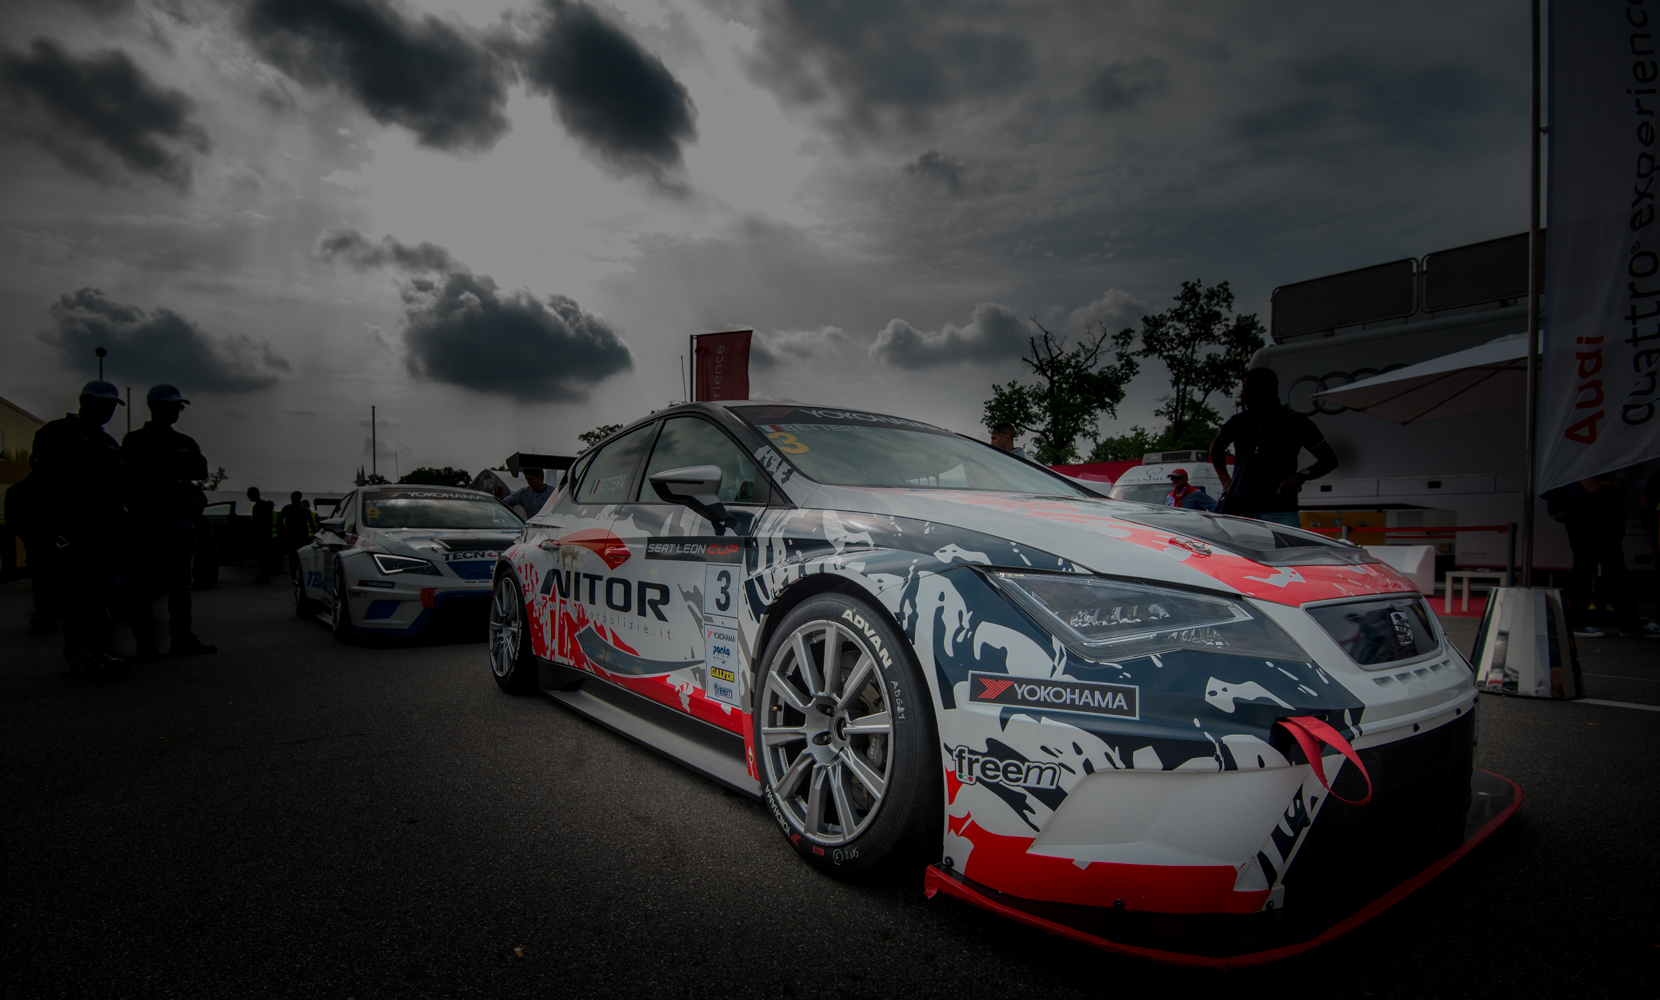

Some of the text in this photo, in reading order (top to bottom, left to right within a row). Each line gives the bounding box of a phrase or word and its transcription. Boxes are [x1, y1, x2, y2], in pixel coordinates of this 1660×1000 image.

[1626, 0, 1660, 231] experienc
[712, 344, 725, 401] rience
[1564, 335, 1604, 444] Audi
[768, 432, 809, 454] 3
[406, 491, 486, 500] YOKOHAMA
[366, 508, 380, 518] 9
[647, 543, 739, 555] SEAT LEON CUP
[540, 568, 670, 623] NITOR
[715, 570, 731, 611] 3
[713, 632, 736, 643] YOKOHAMA
[841, 608, 893, 669] ADVAN
[711, 667, 735, 682] GALFER
[714, 682, 733, 699] freem
[1014, 683, 1128, 711] YOKOHAMA
[953, 746, 1060, 788] freem
